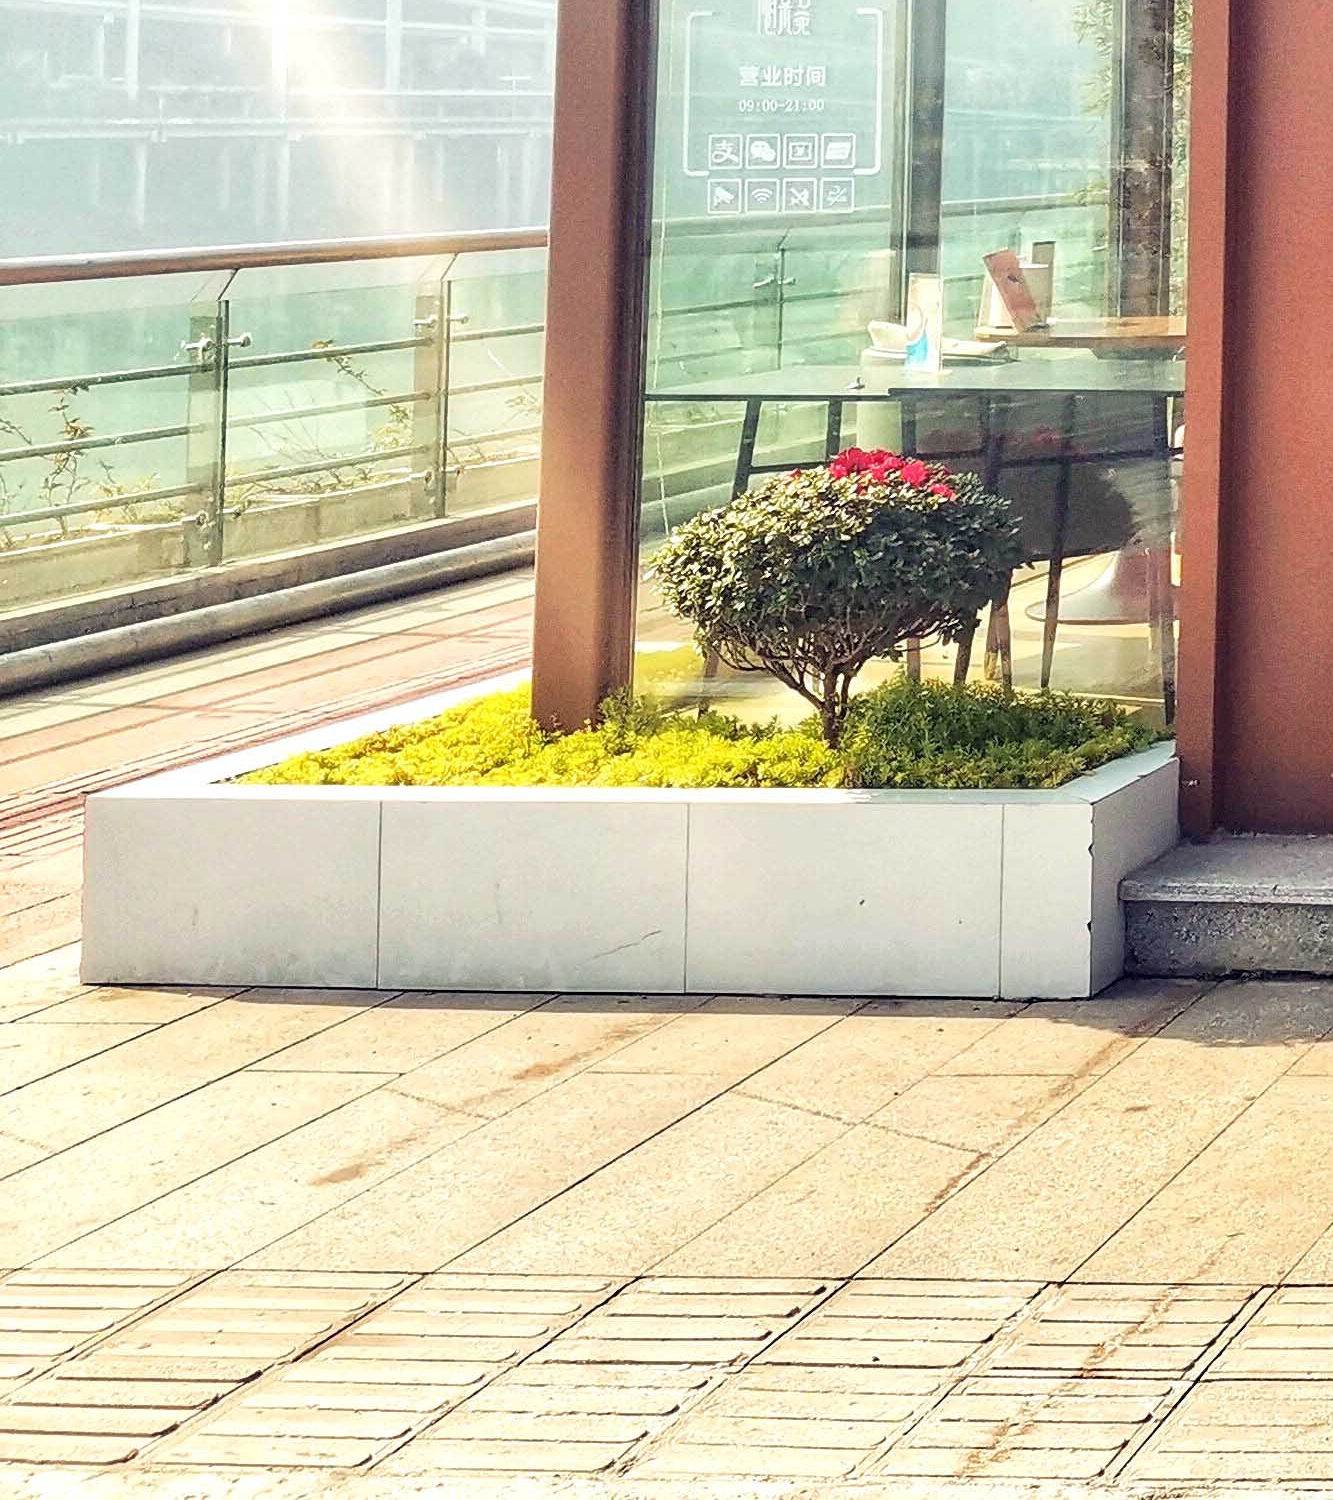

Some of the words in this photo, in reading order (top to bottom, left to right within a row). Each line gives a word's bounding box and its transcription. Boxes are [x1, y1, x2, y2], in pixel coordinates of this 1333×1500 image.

[739, 64, 827, 88] 营业时间
[738, 98, 825, 113] 09:00-21:00
